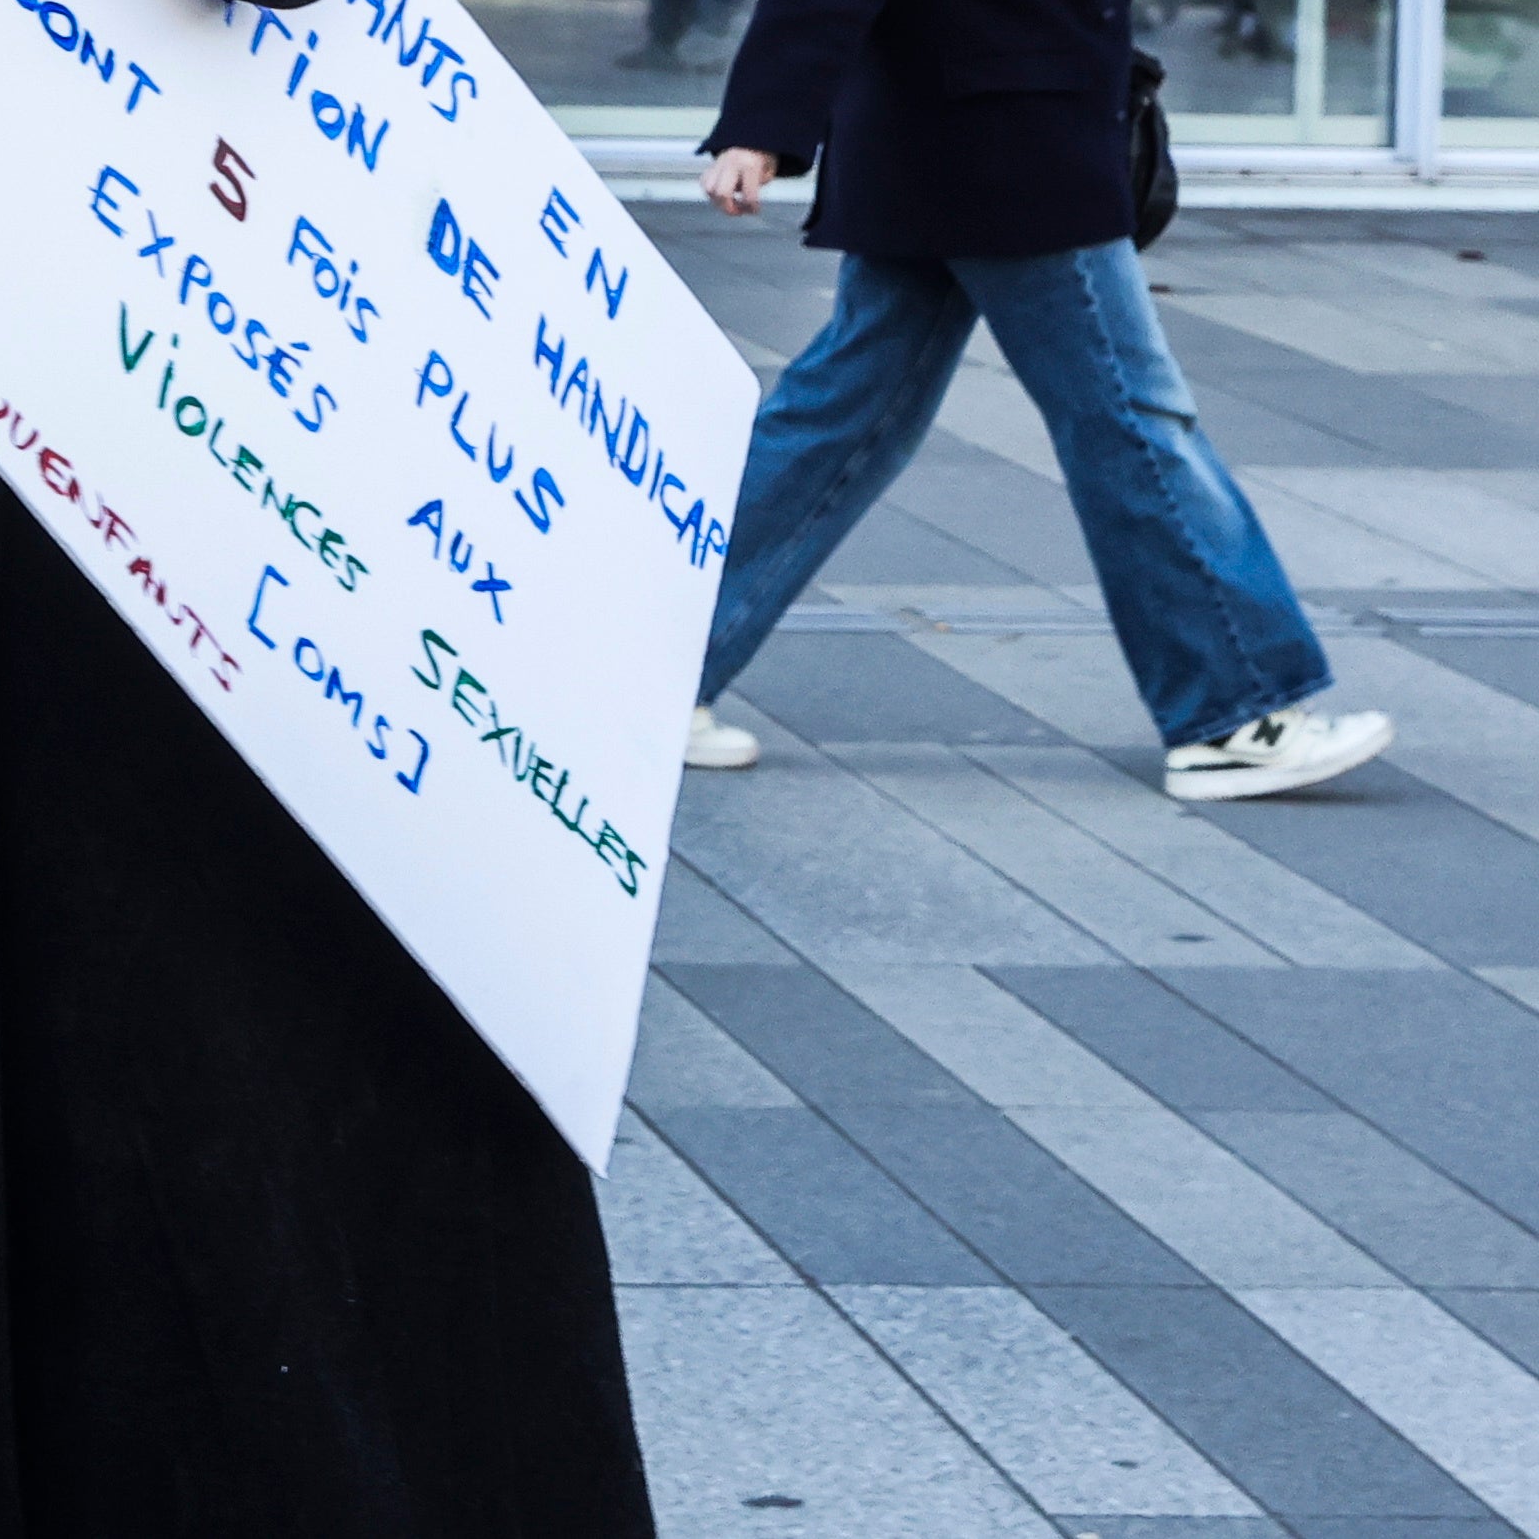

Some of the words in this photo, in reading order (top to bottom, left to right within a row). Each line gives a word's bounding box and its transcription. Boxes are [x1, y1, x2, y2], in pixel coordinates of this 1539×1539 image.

[88, 169, 338, 434] EXPOSÉS
[406, 498, 514, 625] AUX
[212, 141, 253, 220] 5
[415, 353, 566, 535] PLUS
[425, 197, 501, 321] DE
[533, 313, 729, 570] HANDICAP
[539, 186, 629, 319] EN
[411, 628, 648, 898] SEXUELLES
